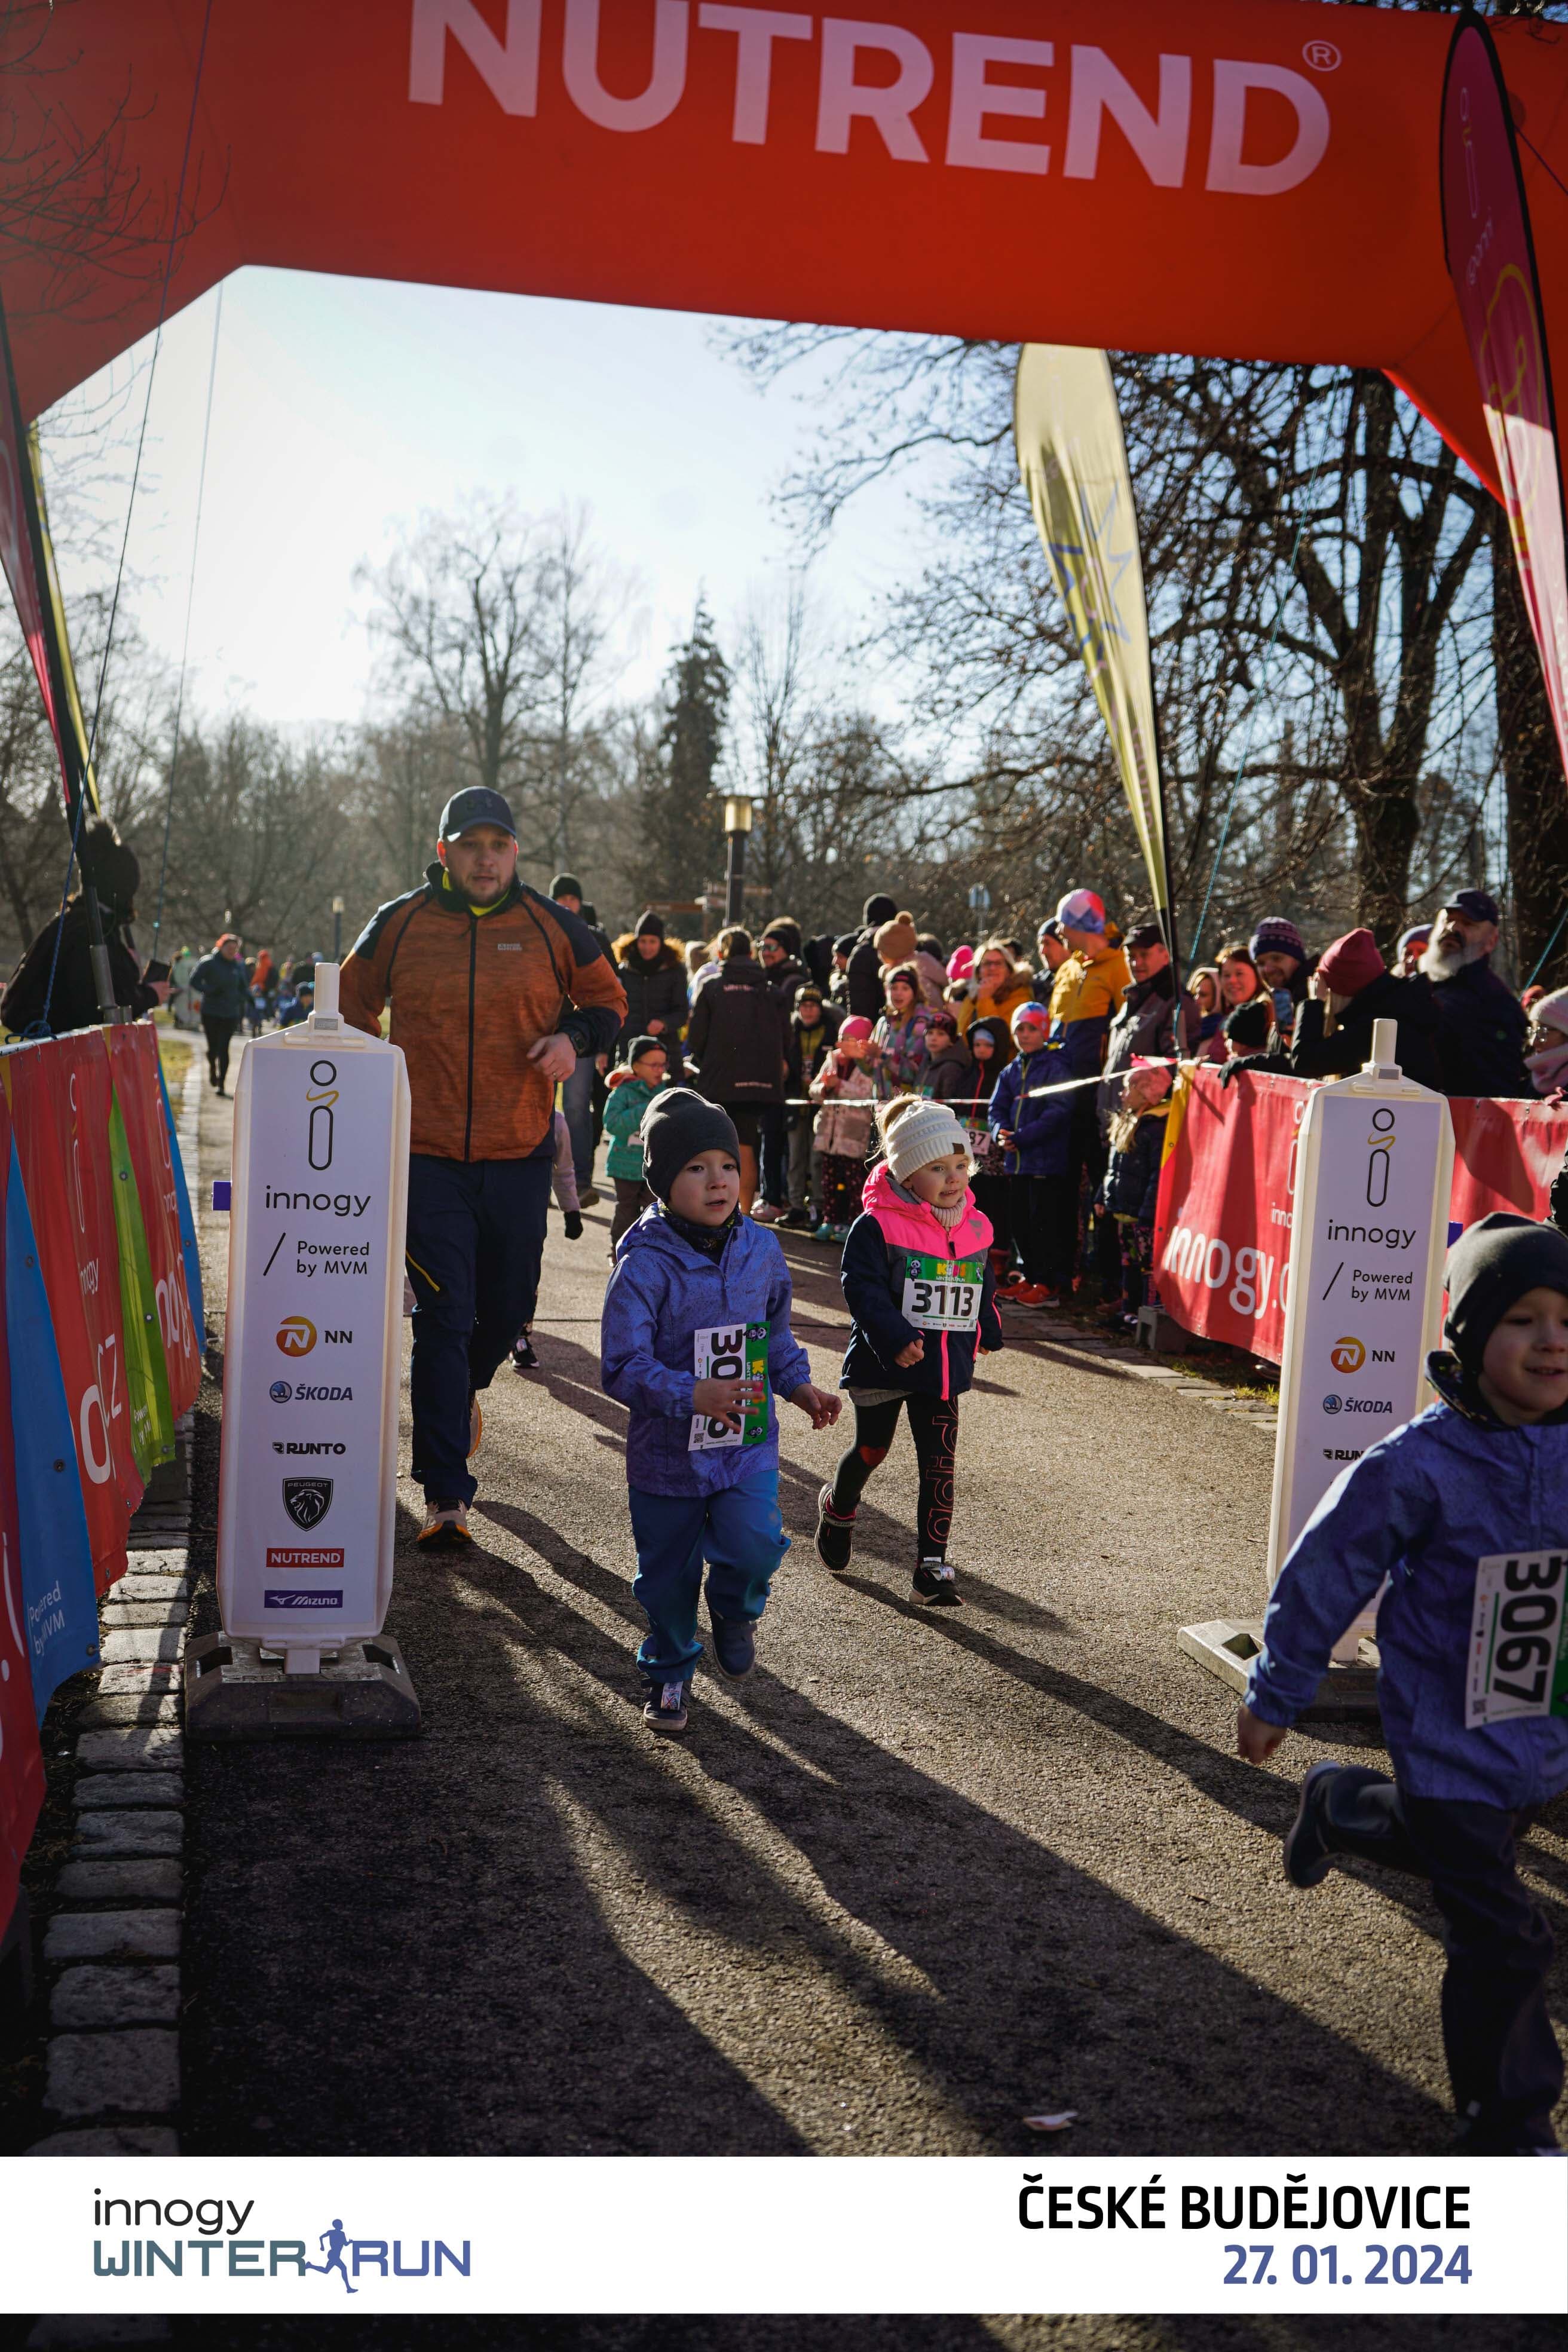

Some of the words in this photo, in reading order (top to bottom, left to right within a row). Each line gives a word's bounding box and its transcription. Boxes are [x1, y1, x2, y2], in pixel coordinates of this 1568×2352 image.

[265, 1185, 371, 1217] innogy
[1271, 1202, 1293, 1229] inno
[1328, 1219, 1416, 1249] innogy
[298, 1241, 369, 1255] Powered
[296, 1259, 317, 1277] by
[324, 1260, 367, 1275] MVM
[1163, 1206, 1290, 1320] innogy.
[1353, 1269, 1413, 1284] Powered
[911, 1282, 974, 1317] 3113
[1351, 1286, 1368, 1302] by
[1374, 1288, 1410, 1301] MVM
[324, 1330, 353, 1344] NN
[1371, 1350, 1395, 1362] NN
[295, 1383, 353, 1401] ŠKODA
[708, 1329, 743, 1439] 306
[1345, 1397, 1393, 1413] ŠKODA
[286, 1443, 346, 1455] RUNTO
[1334, 1450, 1365, 1460] RUN
[271, 1552, 341, 1564] NUTREND
[1493, 1556, 1562, 1702] 3067
